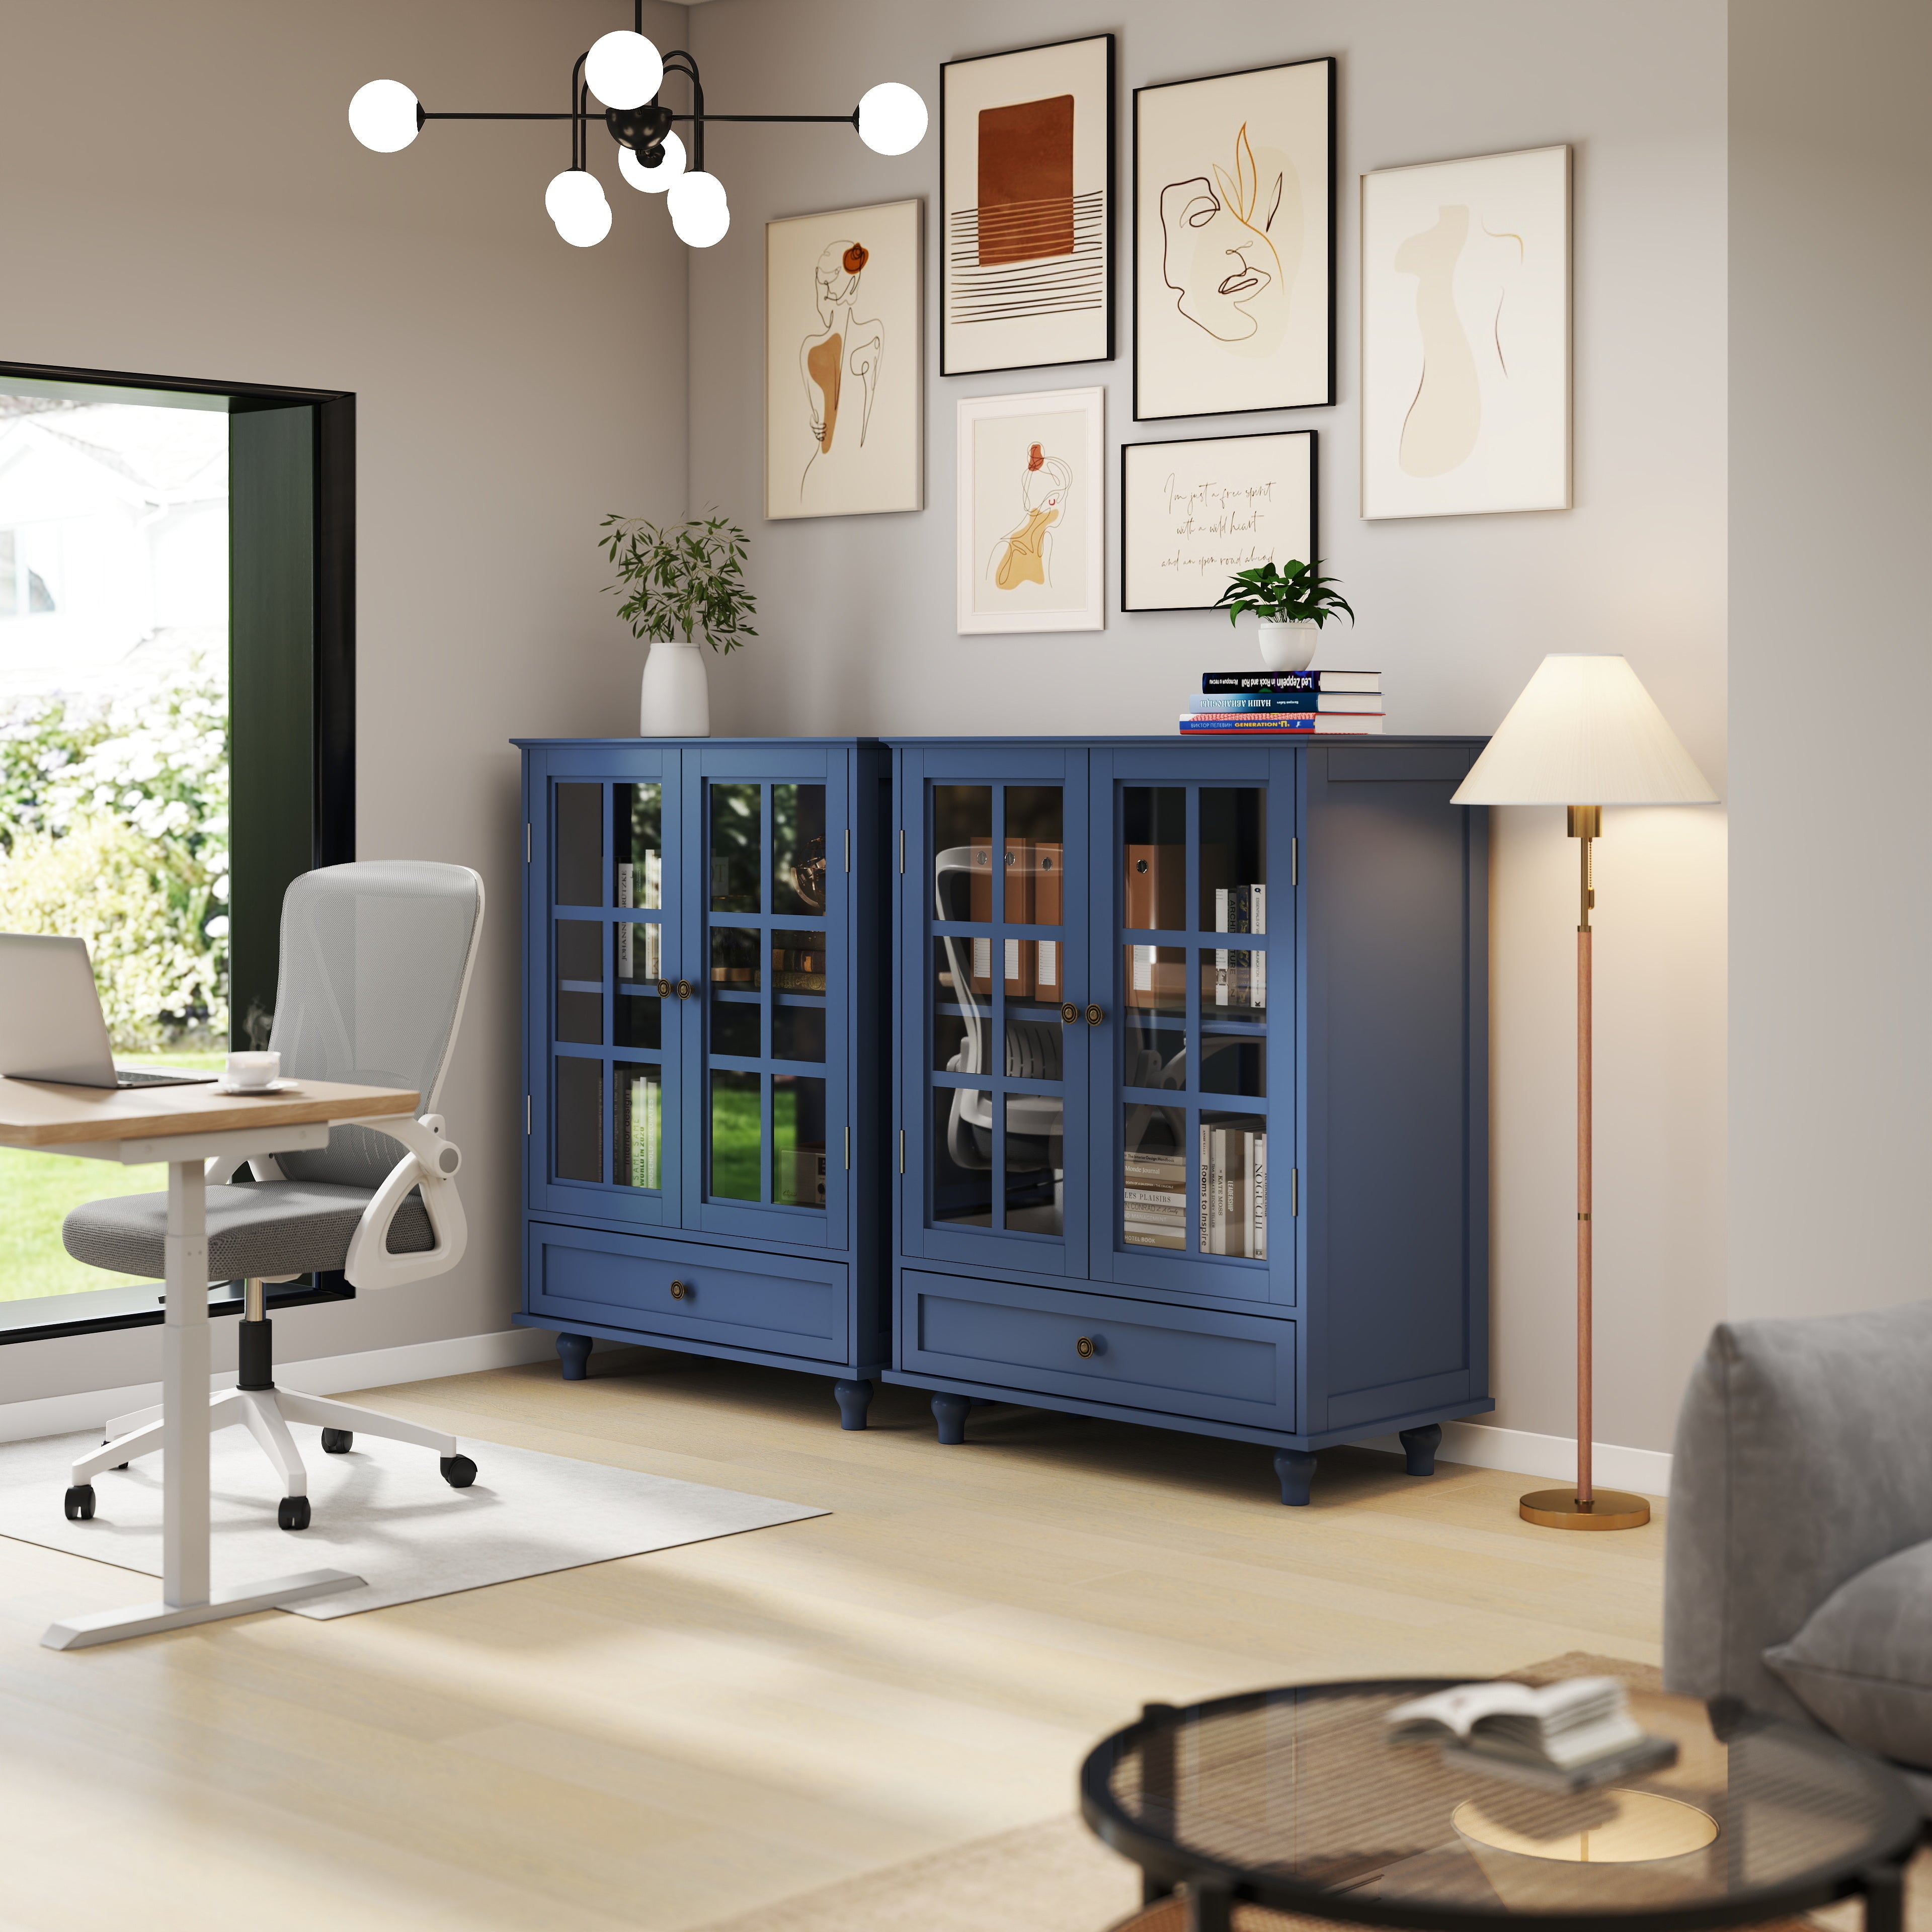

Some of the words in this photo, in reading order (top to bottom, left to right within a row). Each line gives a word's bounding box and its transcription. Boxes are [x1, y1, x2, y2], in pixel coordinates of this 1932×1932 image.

[1187, 481, 1217, 516] just
[1220, 489, 1242, 509] free
[1245, 481, 1276, 508] spirit
[1177, 517, 1196, 540] with
[1210, 515, 1227, 538] wild
[1230, 511, 1264, 534] heart
[1161, 549, 1180, 571] and
[1198, 556, 1217, 576] open
[1220, 548, 1243, 566] road
[1245, 546, 1274, 563] ahead
[1241, 678, 1250, 687] Roll
[1260, 679, 1271, 687] Rock
[1276, 675, 1301, 689] Zeppelin
[1301, 678, 1312, 688] Led
[1139, 1193, 1171, 1203] PLAISIRS
[1255, 1163, 1263, 1229] NOGUCHI
[1131, 1203, 1156, 1212] CONRAD
[1201, 1199, 1208, 1210] to
[1200, 1213, 1209, 1246] Inspire
